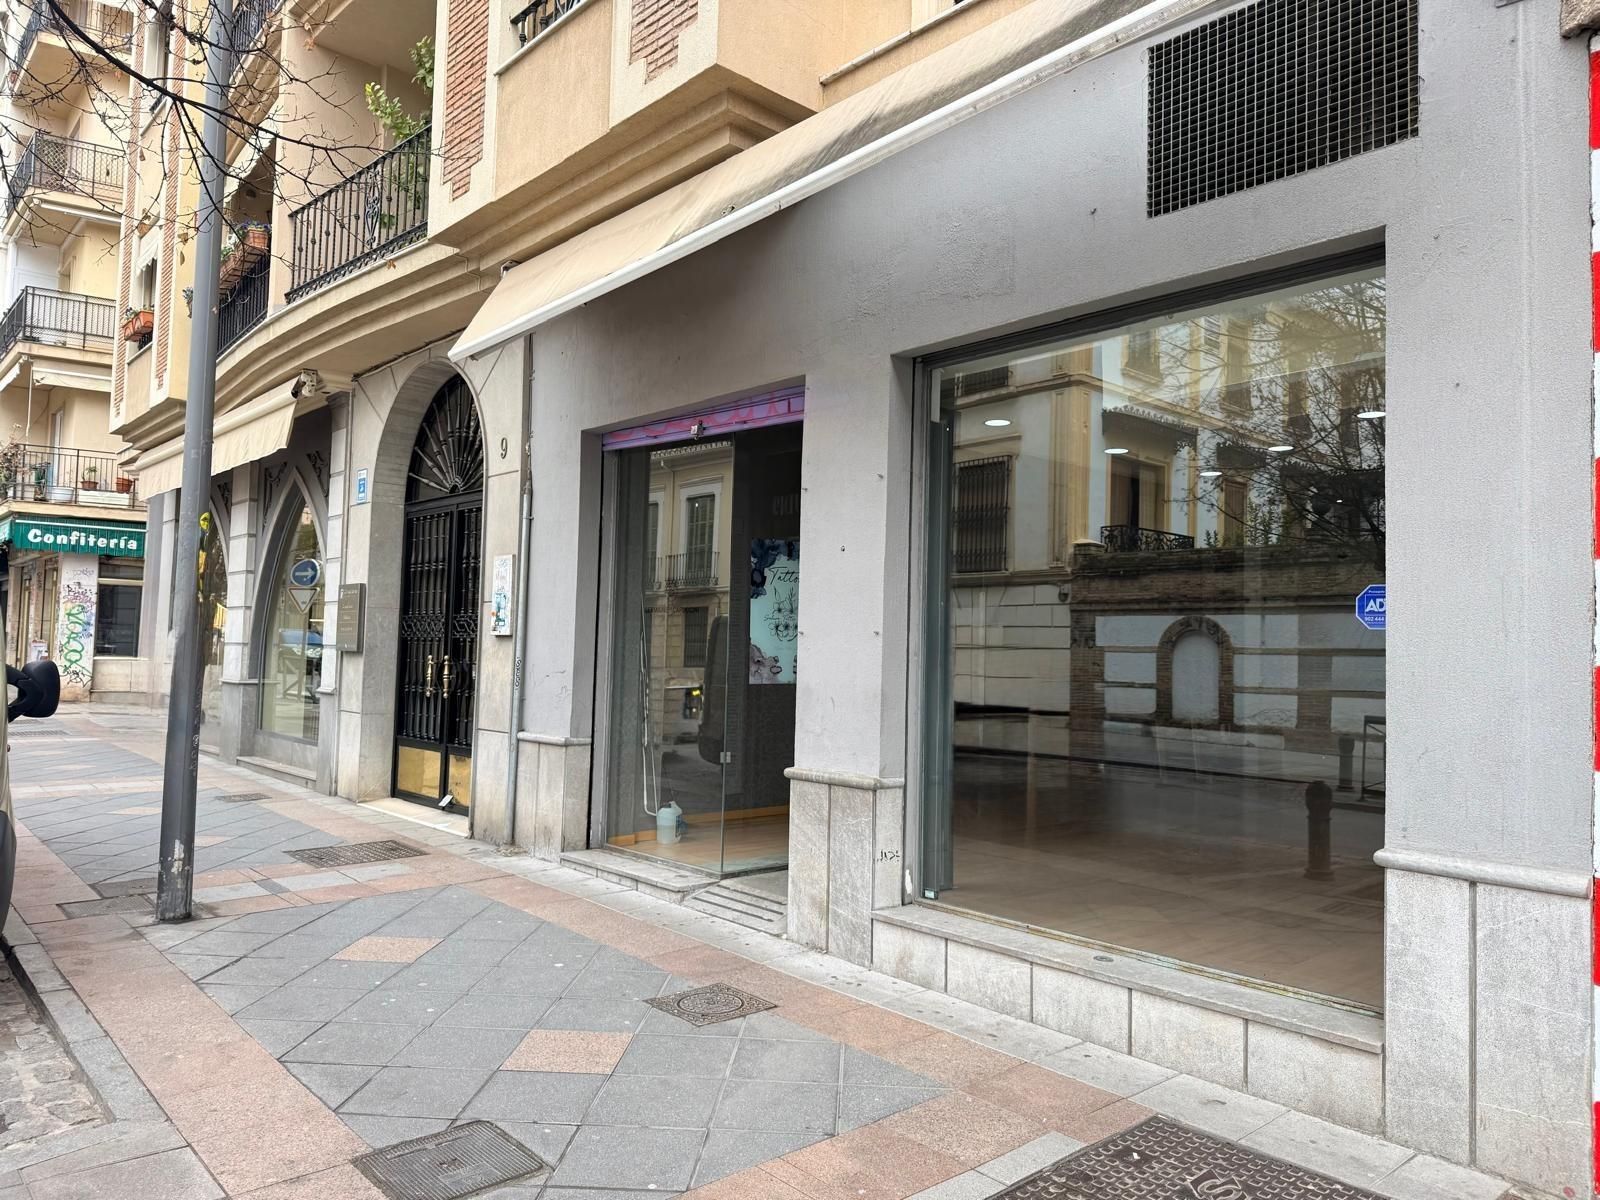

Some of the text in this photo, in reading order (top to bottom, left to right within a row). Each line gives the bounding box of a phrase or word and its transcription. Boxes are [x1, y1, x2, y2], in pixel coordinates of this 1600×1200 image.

[500, 437, 508, 459] 9
[27, 528, 138, 550] Confitería
[1365, 598, 1386, 612] AD
